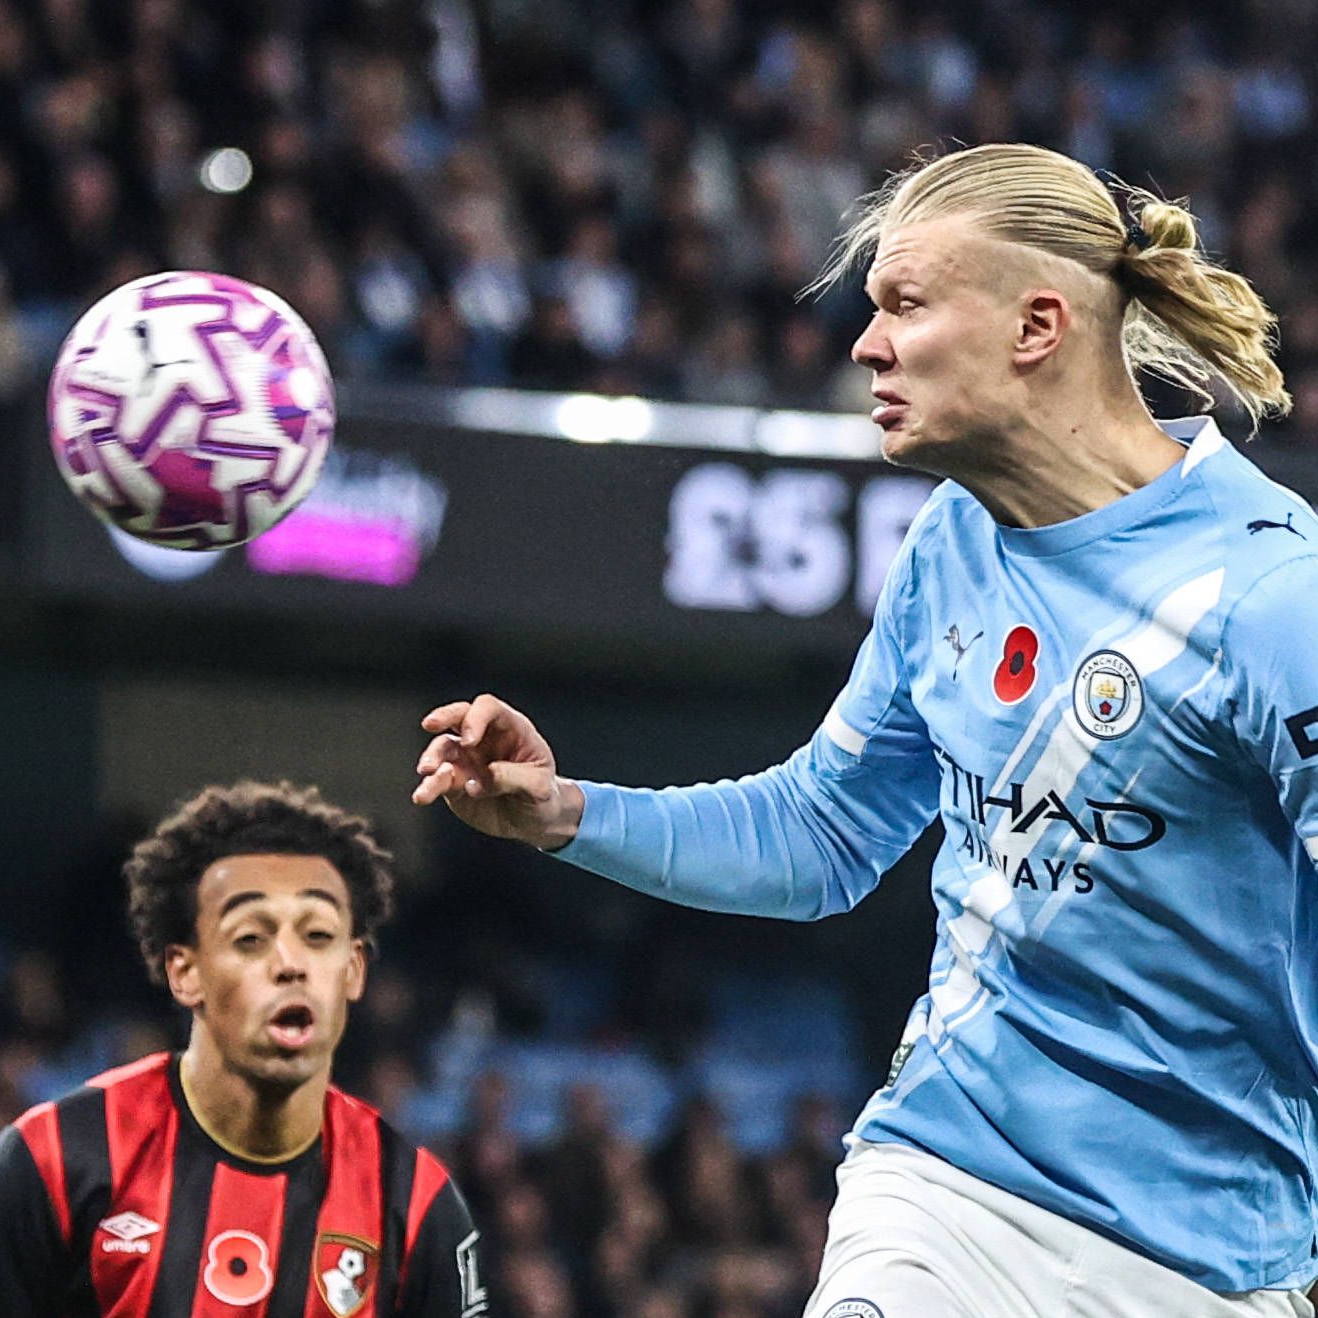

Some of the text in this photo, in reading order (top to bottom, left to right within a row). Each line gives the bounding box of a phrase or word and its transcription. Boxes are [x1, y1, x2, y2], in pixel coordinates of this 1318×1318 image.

[1081, 656, 1138, 688] MANCHESTER
[1093, 723, 1117, 735] CITY
[930, 740, 1167, 852] TIHAD
[101, 1238, 151, 1254] umbro
